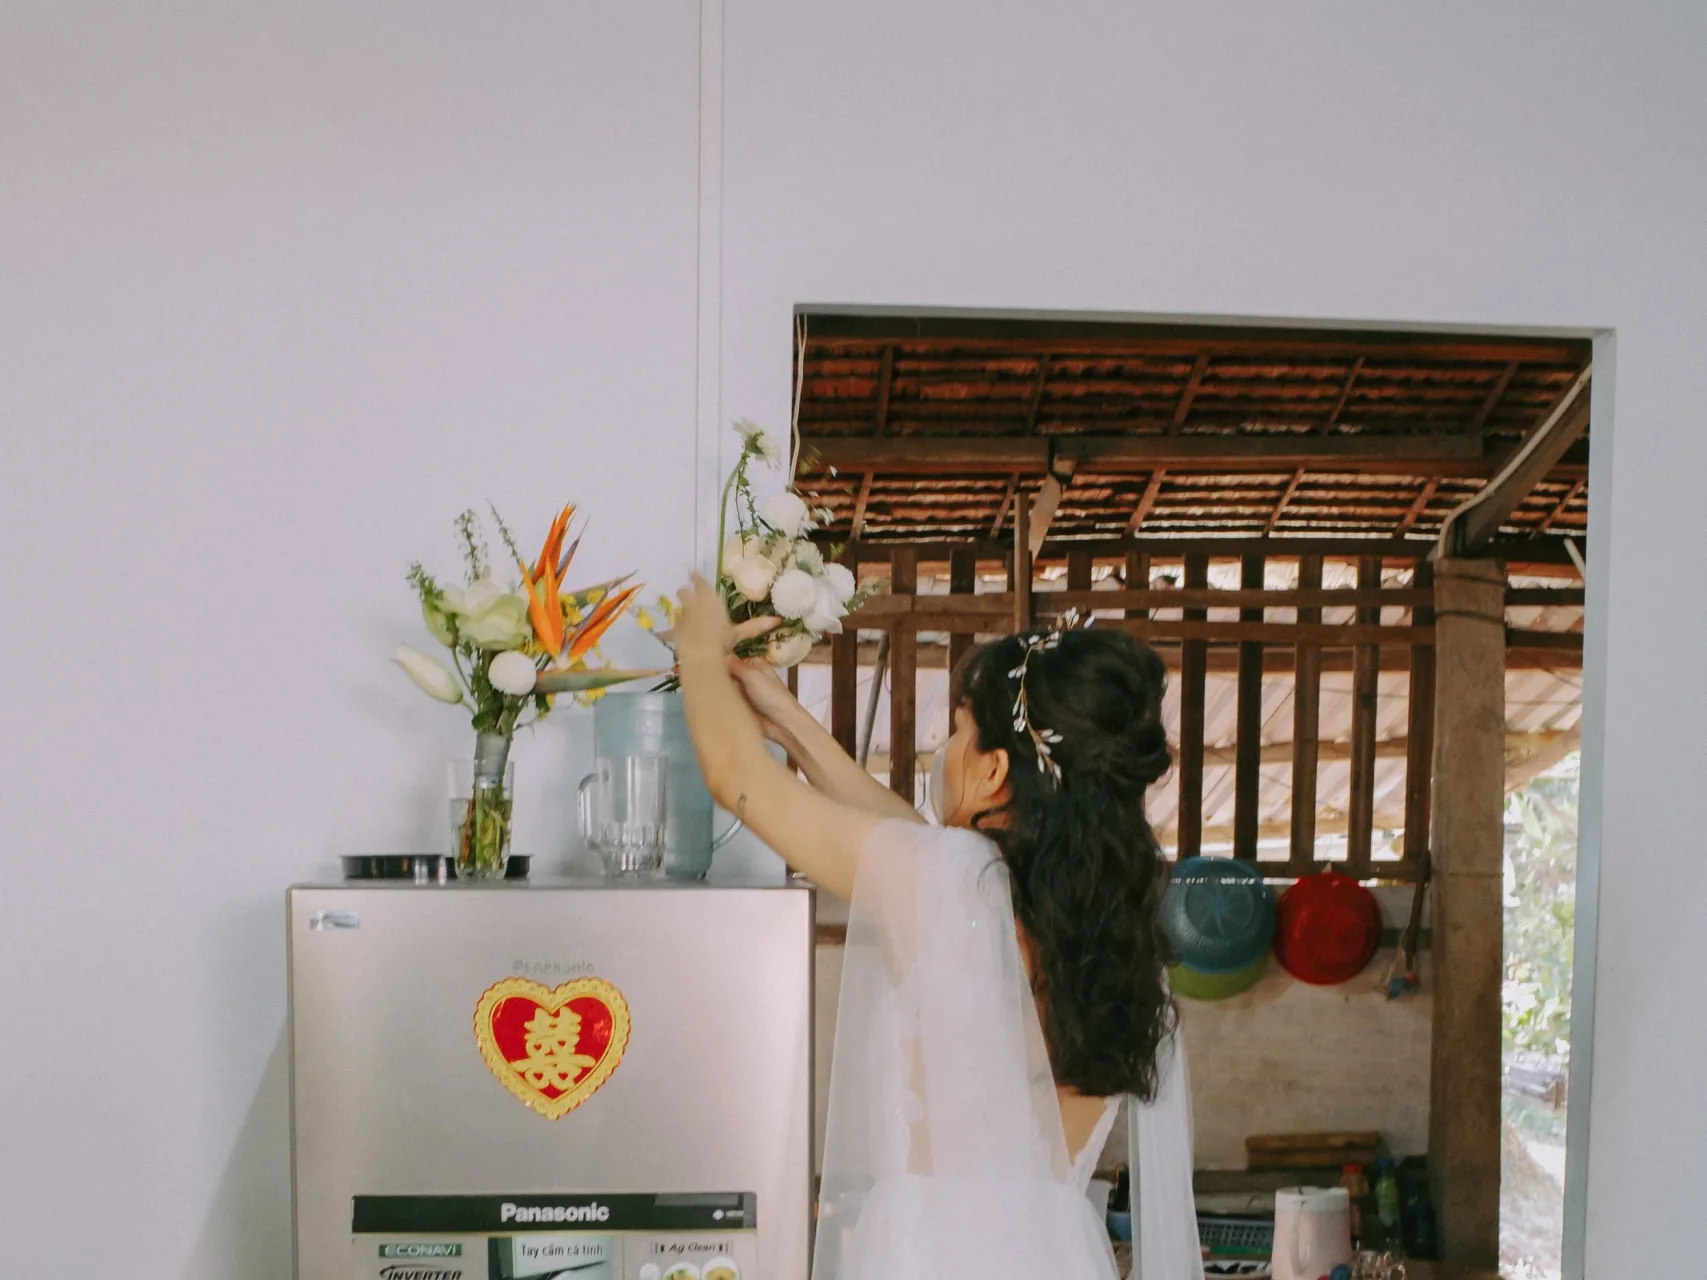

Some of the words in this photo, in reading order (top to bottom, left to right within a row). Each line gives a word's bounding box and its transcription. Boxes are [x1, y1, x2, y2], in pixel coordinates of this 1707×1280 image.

[500, 1202, 610, 1223] Panasonic
[384, 1244, 456, 1257] ECONAVI
[521, 1244, 540, 1259] Tay
[669, 1243, 686, 1253] Ag
[687, 1243, 716, 1252] Clean
